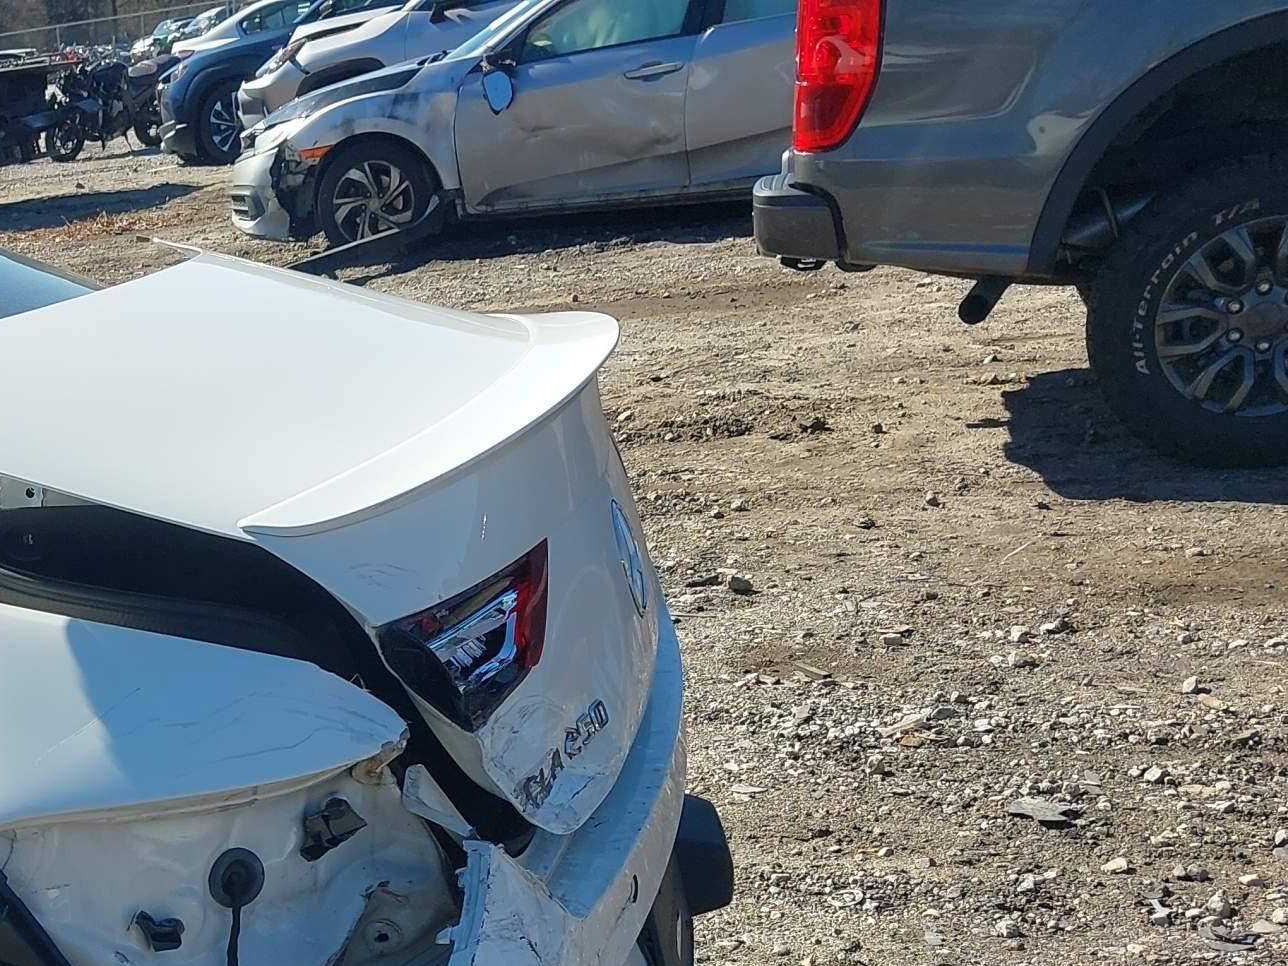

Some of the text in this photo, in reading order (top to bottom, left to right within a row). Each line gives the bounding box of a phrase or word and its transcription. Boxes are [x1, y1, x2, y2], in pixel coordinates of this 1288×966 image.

[1131, 199, 1260, 376] All-Terrain T/A
[564, 699, 608, 759] 250
